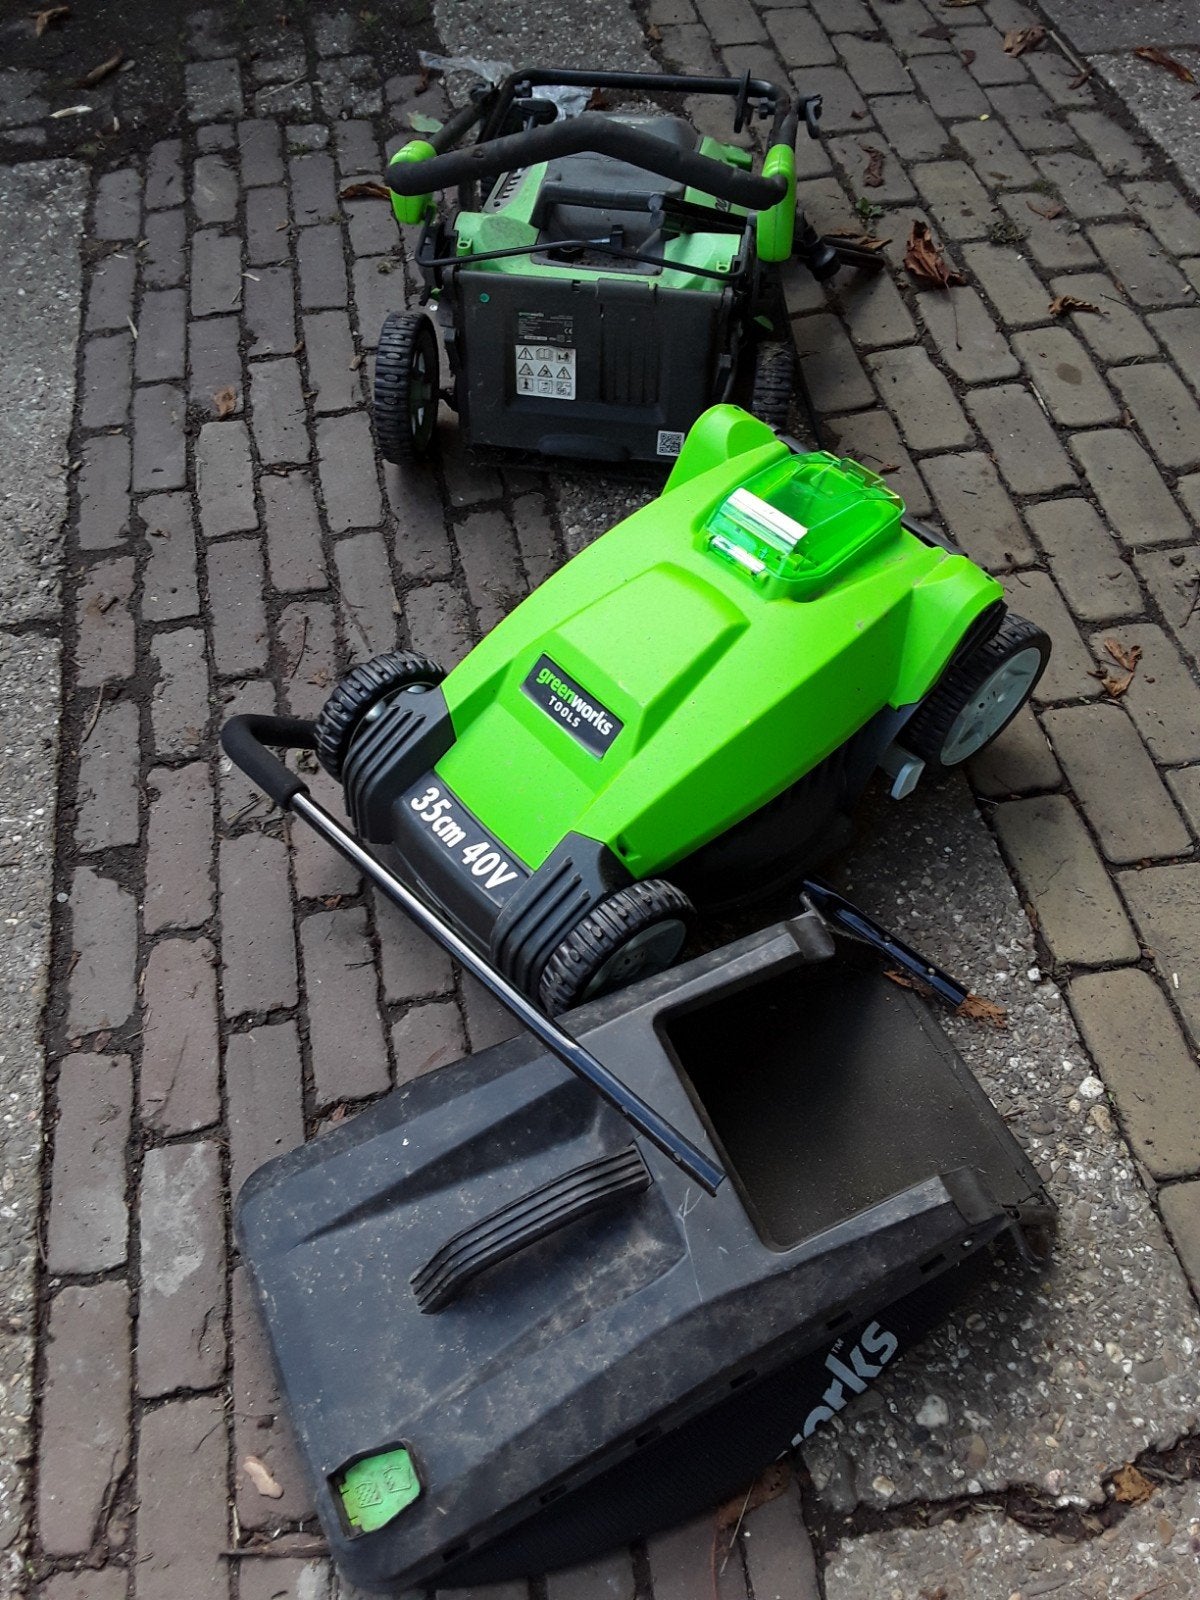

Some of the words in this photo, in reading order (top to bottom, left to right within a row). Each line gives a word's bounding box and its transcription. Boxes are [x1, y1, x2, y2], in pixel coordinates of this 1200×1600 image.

[536, 668, 613, 735] greenworks
[548, 695, 581, 727] TOOLS
[410, 787, 466, 848] 35cm
[461, 841, 519, 889] 40V
[790, 1320, 898, 1447] orks
